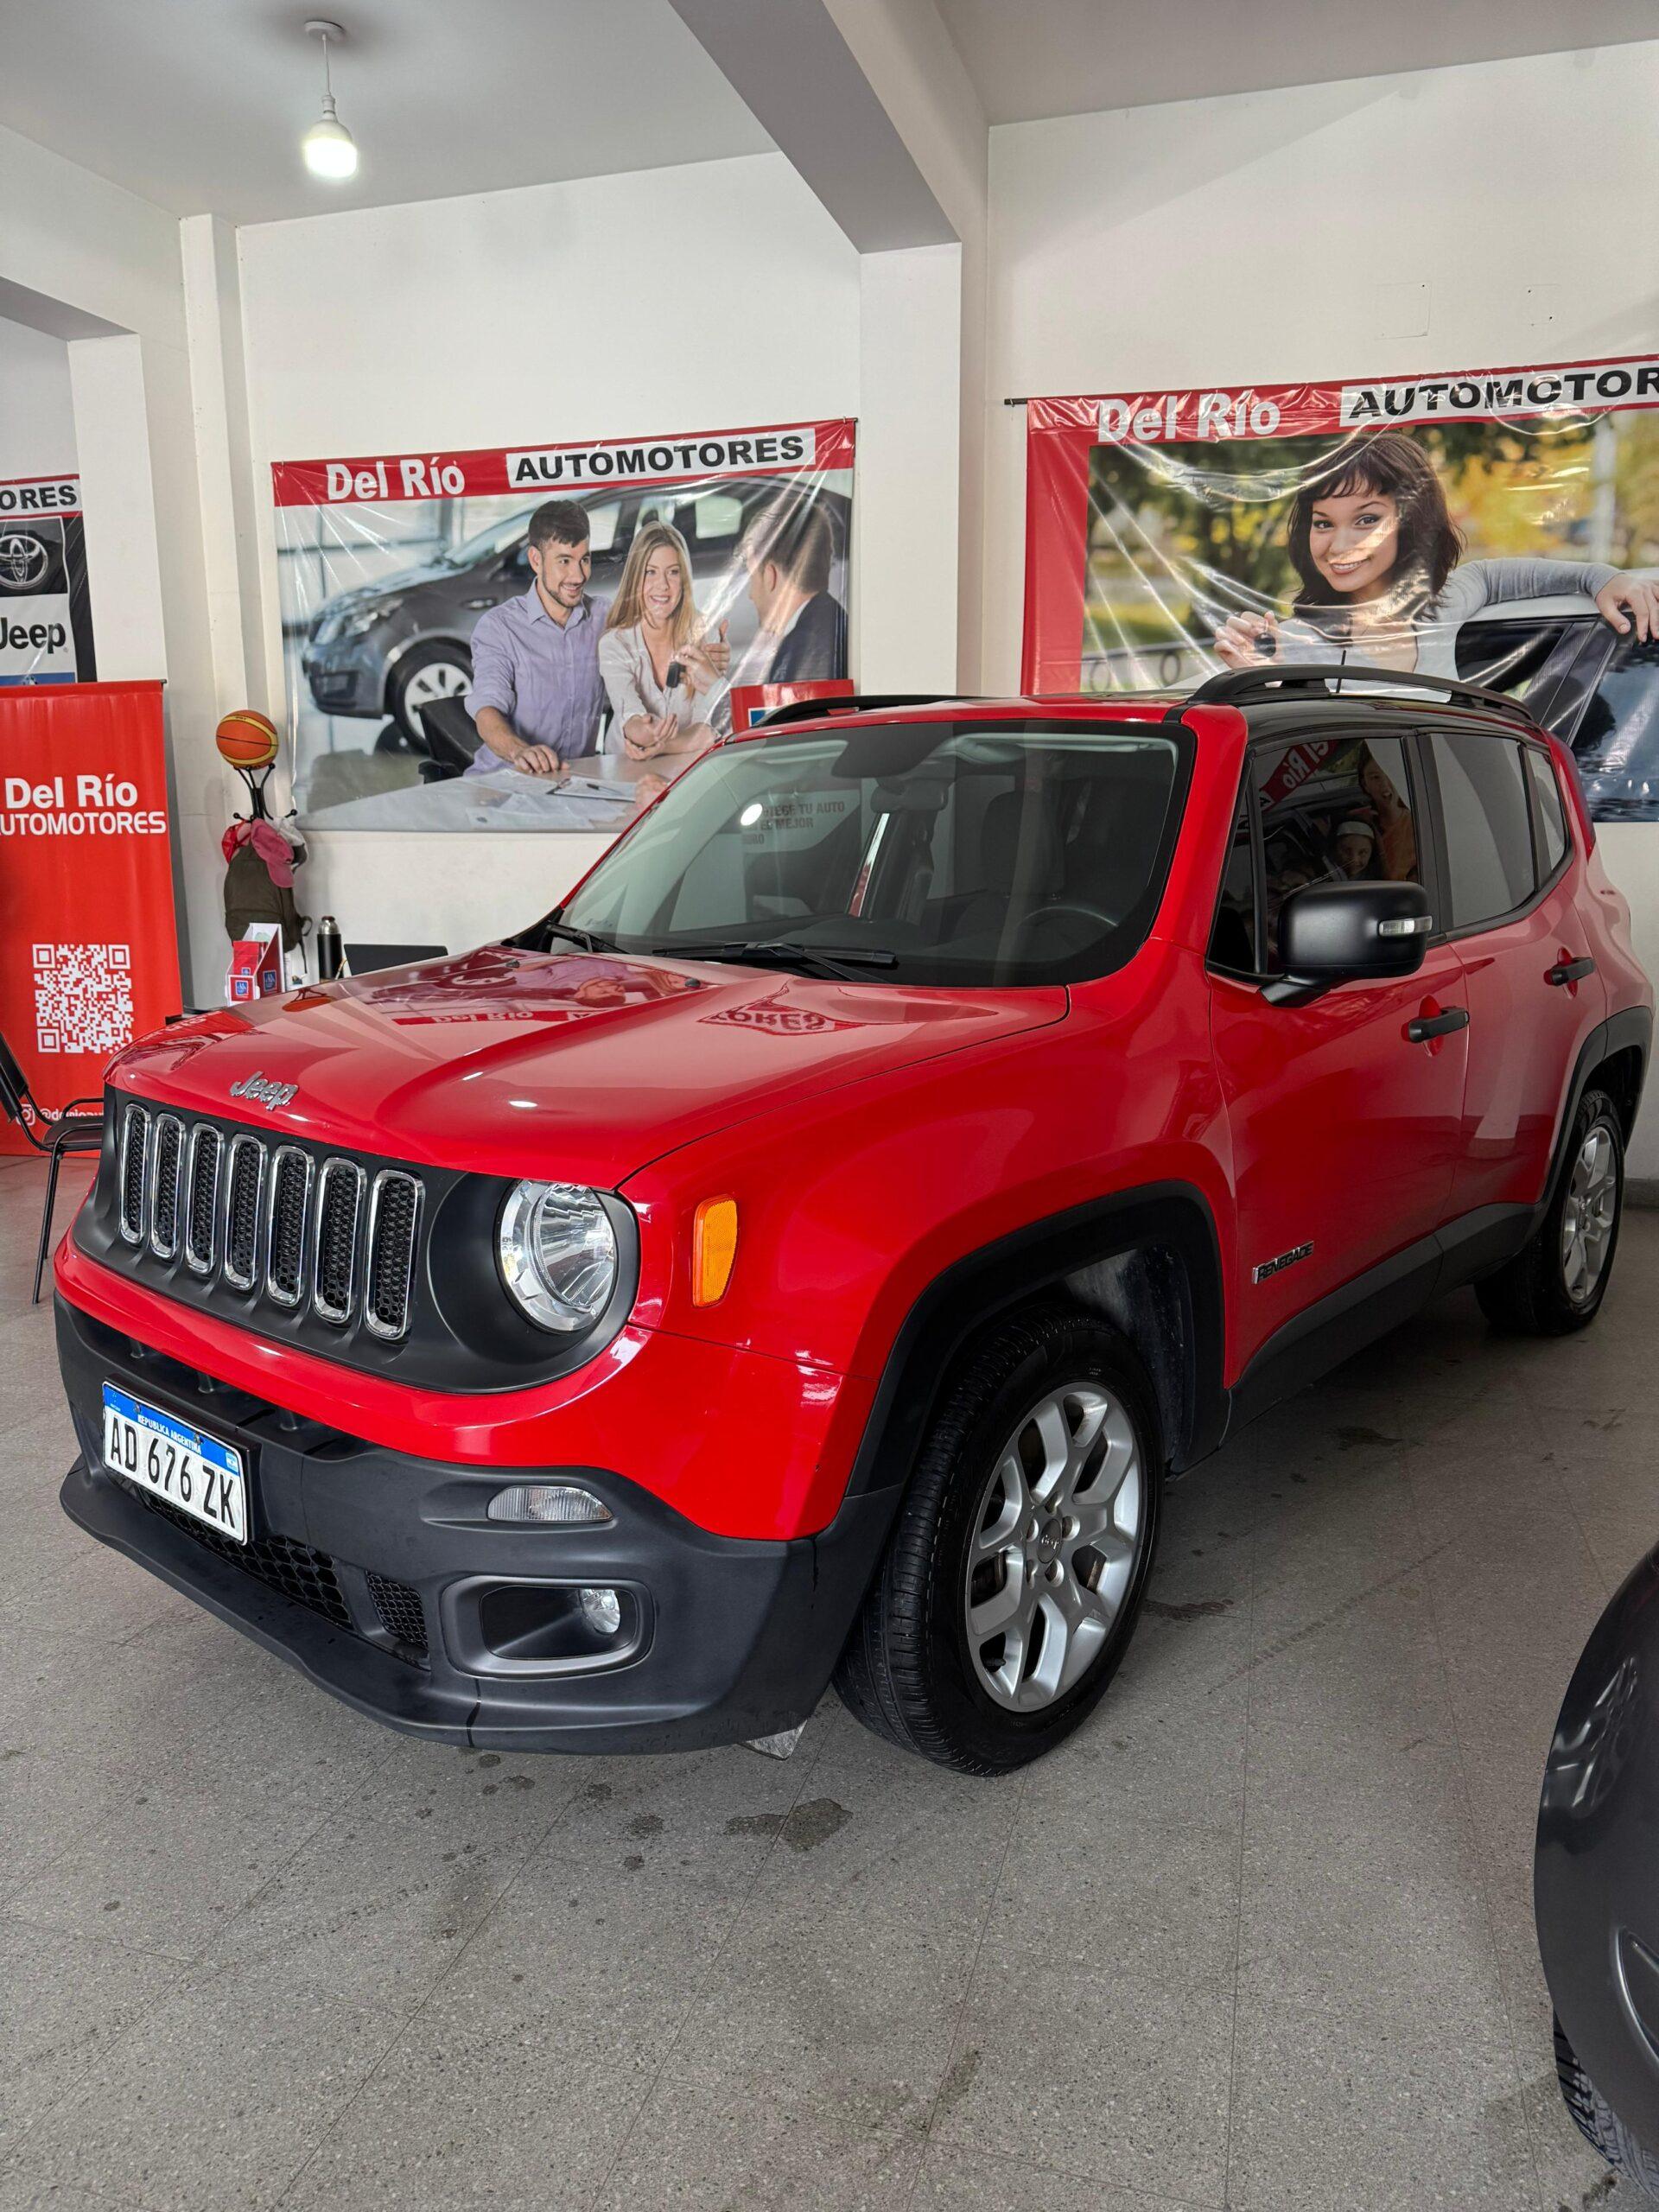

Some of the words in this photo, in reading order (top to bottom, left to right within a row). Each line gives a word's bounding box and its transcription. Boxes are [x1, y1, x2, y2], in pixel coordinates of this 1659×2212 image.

[1098, 396, 1178, 442] Del
[1348, 367, 1659, 419] AUTOMOTOR
[326, 461, 388, 500] Del
[400, 456, 465, 497] Río
[515, 435, 804, 481] AUTOMOTORES
[0, 485, 77, 510] ORES
[0, 617, 66, 654] Jeep
[5, 777, 64, 809] Del
[77, 773, 138, 807] Río
[817, 801, 845, 814] AUTO
[0, 811, 167, 836] UTOMOTORES
[776, 817, 814, 830] MEJOR
[229, 1071, 299, 1111] Jeep
[1251, 1240, 1314, 1285] RENEGADE
[111, 1416, 137, 1472] AD
[148, 1438, 192, 1503] 676
[203, 1466, 235, 1529] ZK
